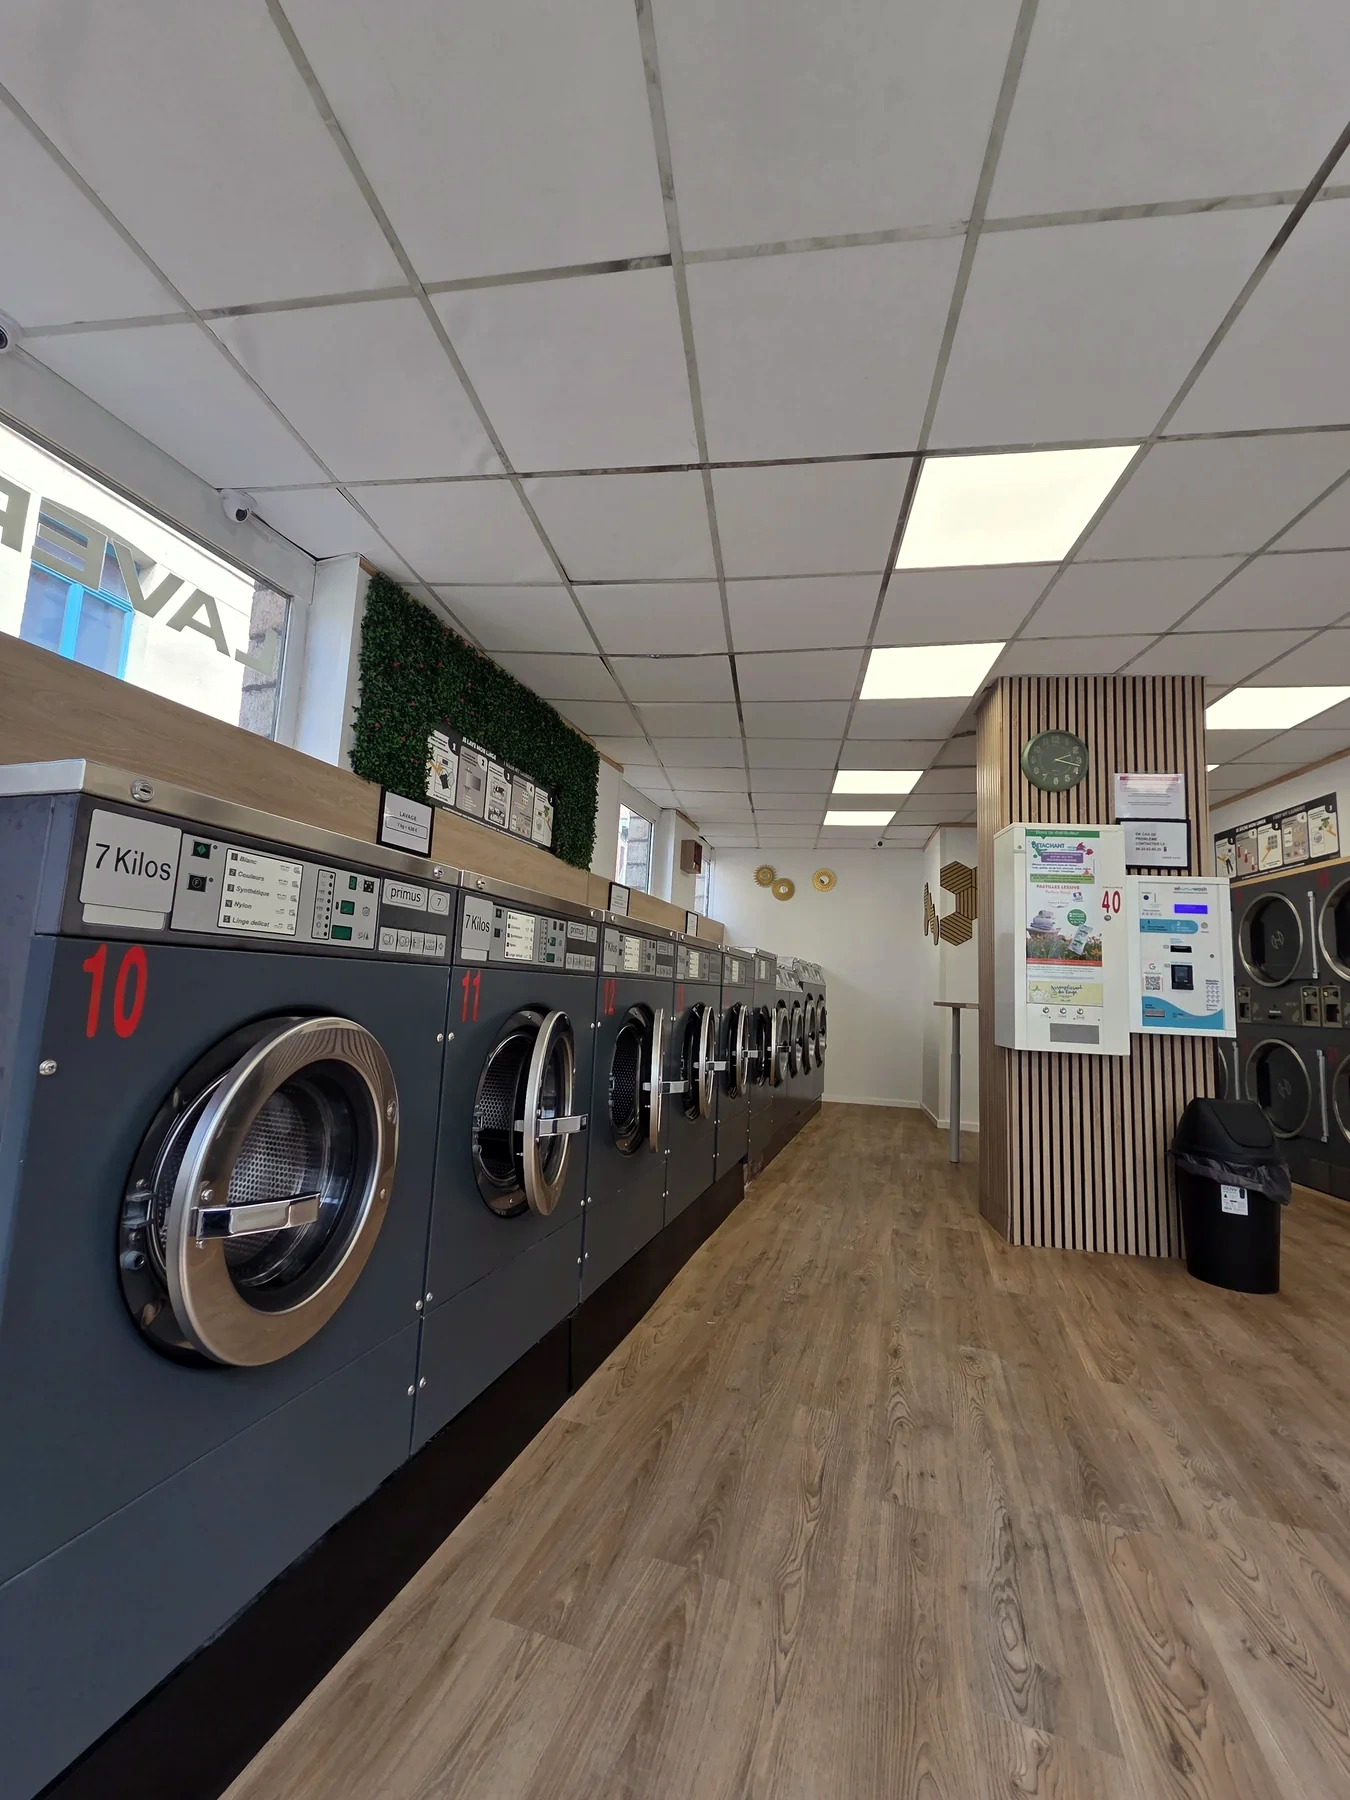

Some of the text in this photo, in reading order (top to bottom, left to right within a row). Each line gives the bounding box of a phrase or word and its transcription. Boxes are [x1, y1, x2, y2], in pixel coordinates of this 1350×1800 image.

[399, 811, 417, 821] LAVAGE
[95, 842, 172, 881] 7 Kilos
[240, 856, 257, 865] Blanc
[238, 871, 264, 882] Couleurs
[390, 887, 421, 903] primus
[234, 901, 252, 909] Nylon
[436, 898, 442, 906] 7
[1102, 890, 1121, 914] 40
[232, 917, 249, 925] Linge
[465, 914, 490, 933] 7 Kilos
[83, 943, 147, 1039] 10
[461, 969, 481, 1022] 11
